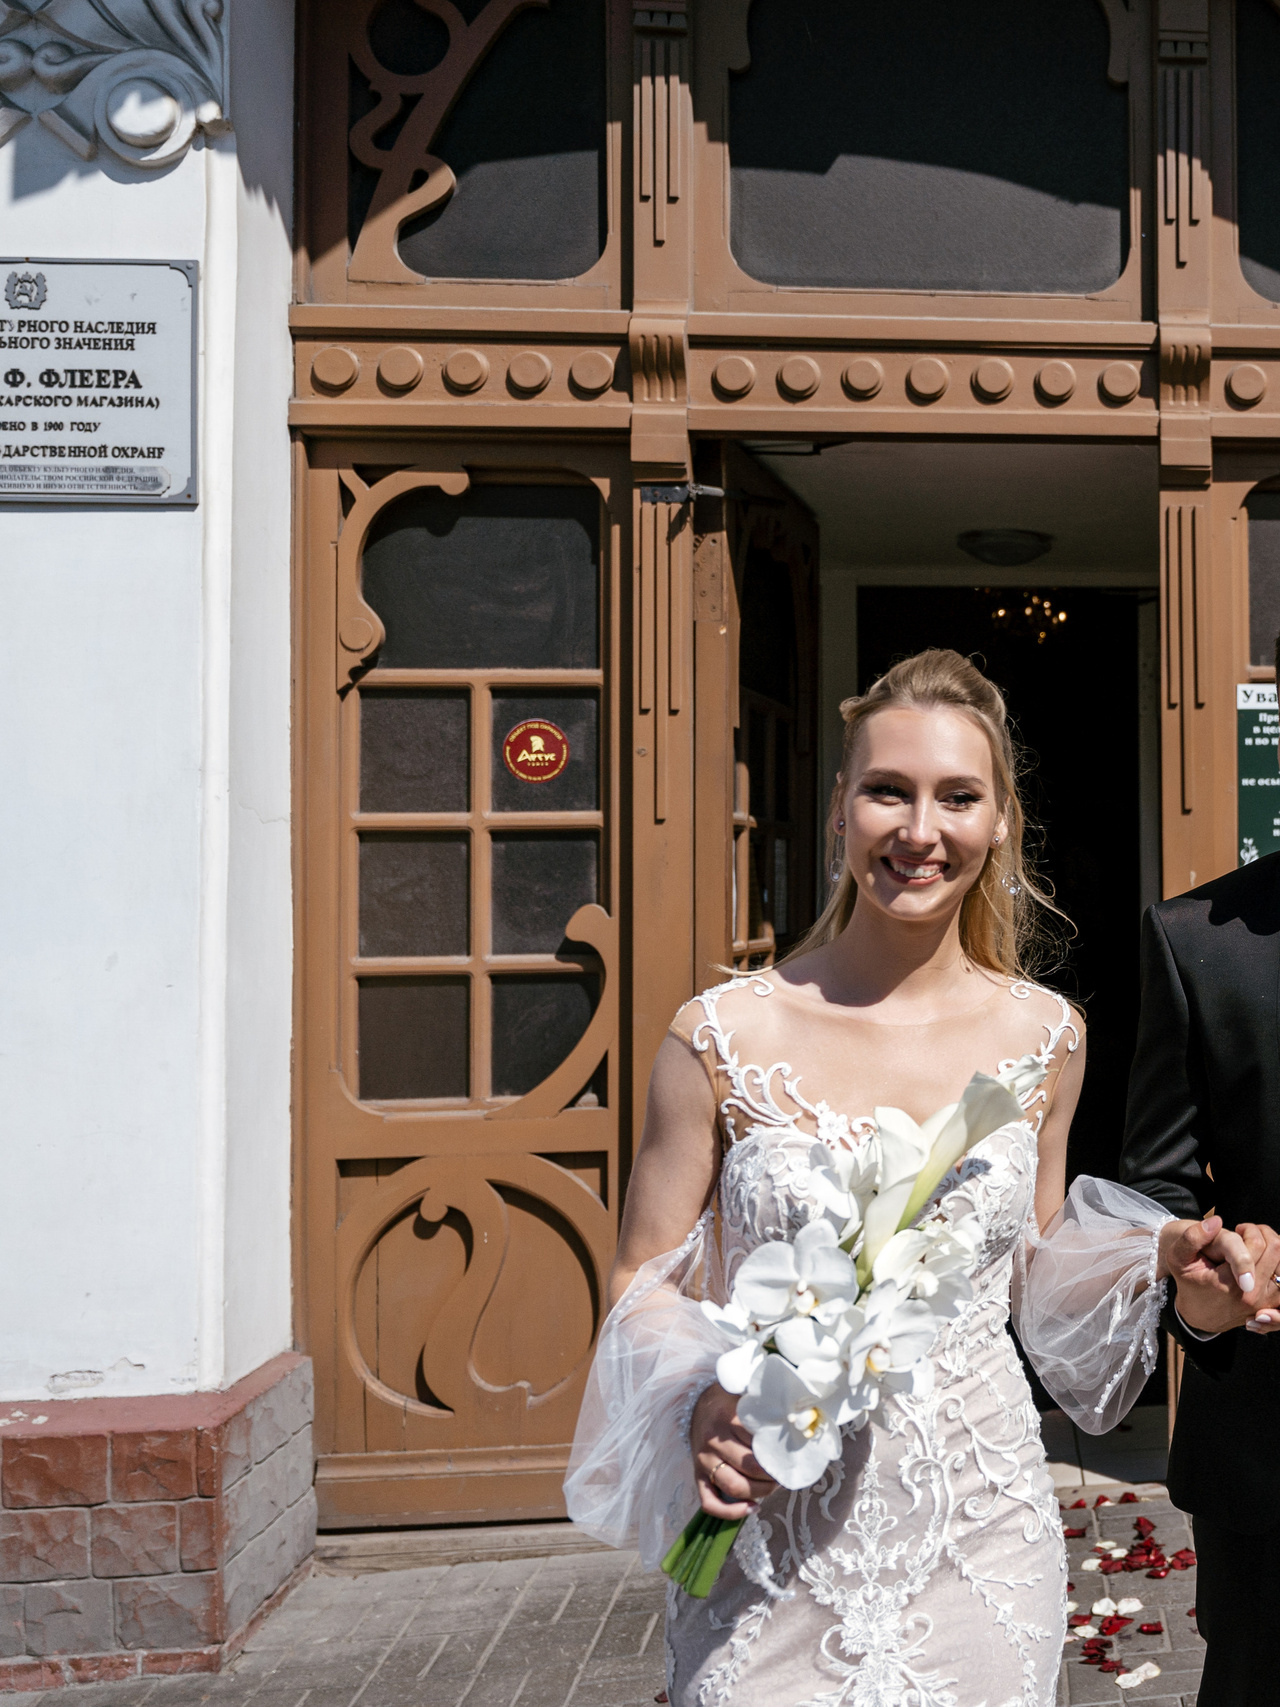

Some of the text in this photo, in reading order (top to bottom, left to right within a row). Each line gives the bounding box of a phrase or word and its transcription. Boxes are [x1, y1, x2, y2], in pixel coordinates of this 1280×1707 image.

[73, 320, 157, 336] НАСЛЕДИЯ
[54, 336, 135, 351] ЗНАЧЕНИЯ
[4, 368, 142, 389] Ф. ФЛЕЕРА
[76, 395, 160, 410] МАГАЗИНА)
[31, 421, 39, 432] В
[43, 421, 64, 432] 1900
[69, 421, 102, 434] ГОДУ
